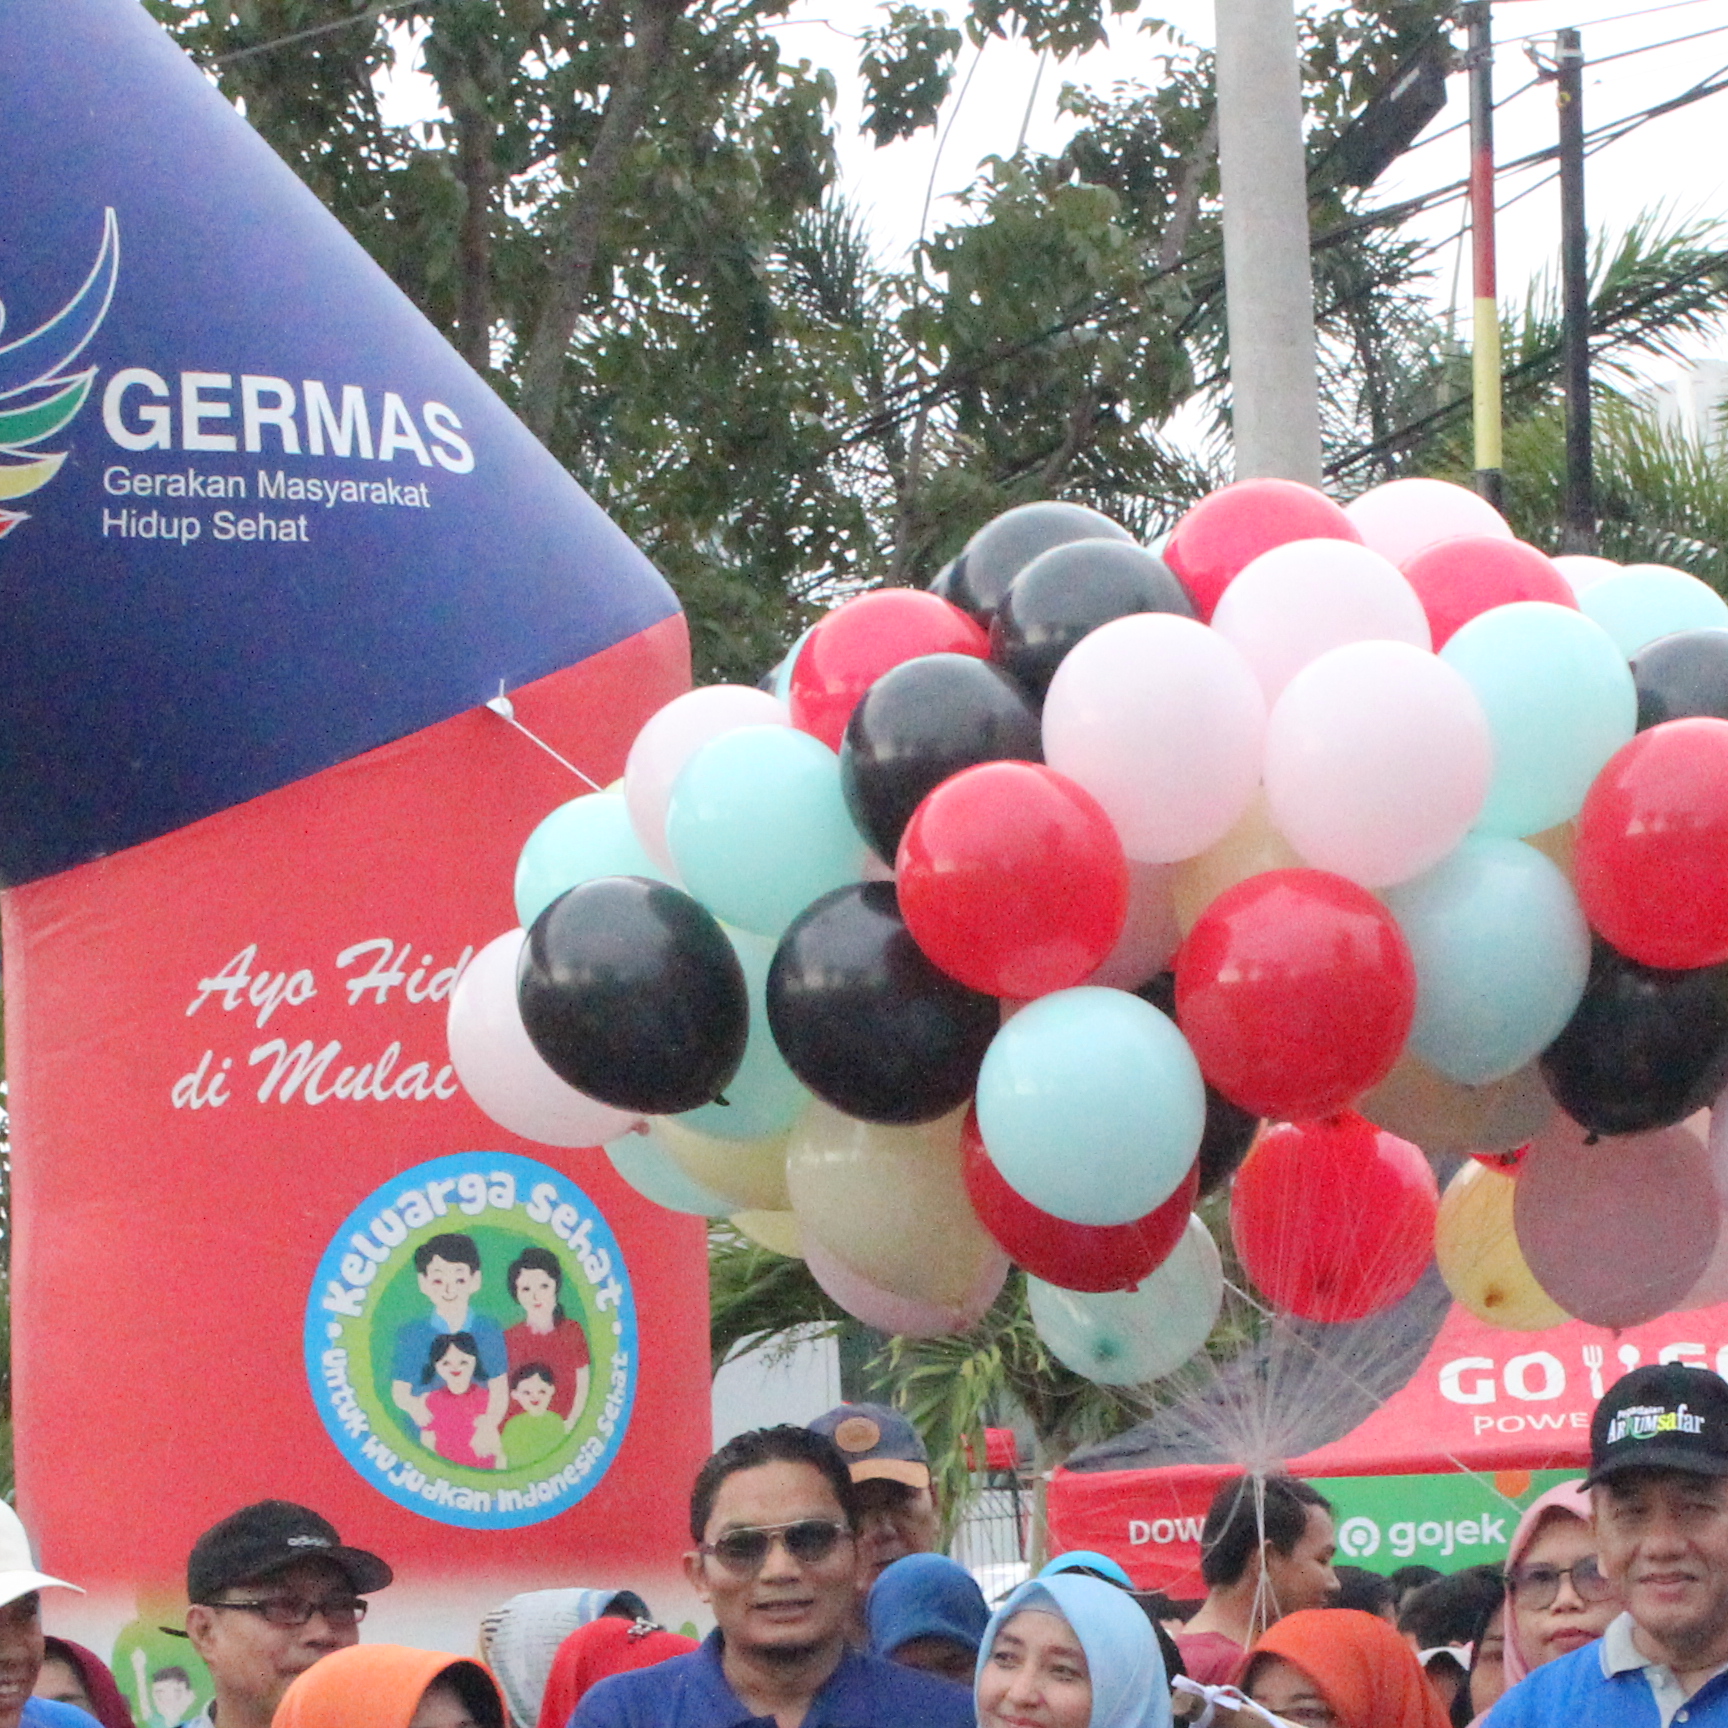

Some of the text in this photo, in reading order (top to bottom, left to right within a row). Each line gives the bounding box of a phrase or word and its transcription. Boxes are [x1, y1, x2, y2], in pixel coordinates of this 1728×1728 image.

[102, 367, 475, 475] GERMAS
[102, 465, 431, 509] Gerakan Masyarakat
[102, 507, 310, 546] Hidup Sehat
[185, 943, 318, 1029] Ayo
[171, 1049, 231, 1110] di
[1438, 1351, 1566, 1405] GO
[1388, 1513, 1507, 1557] gojek
